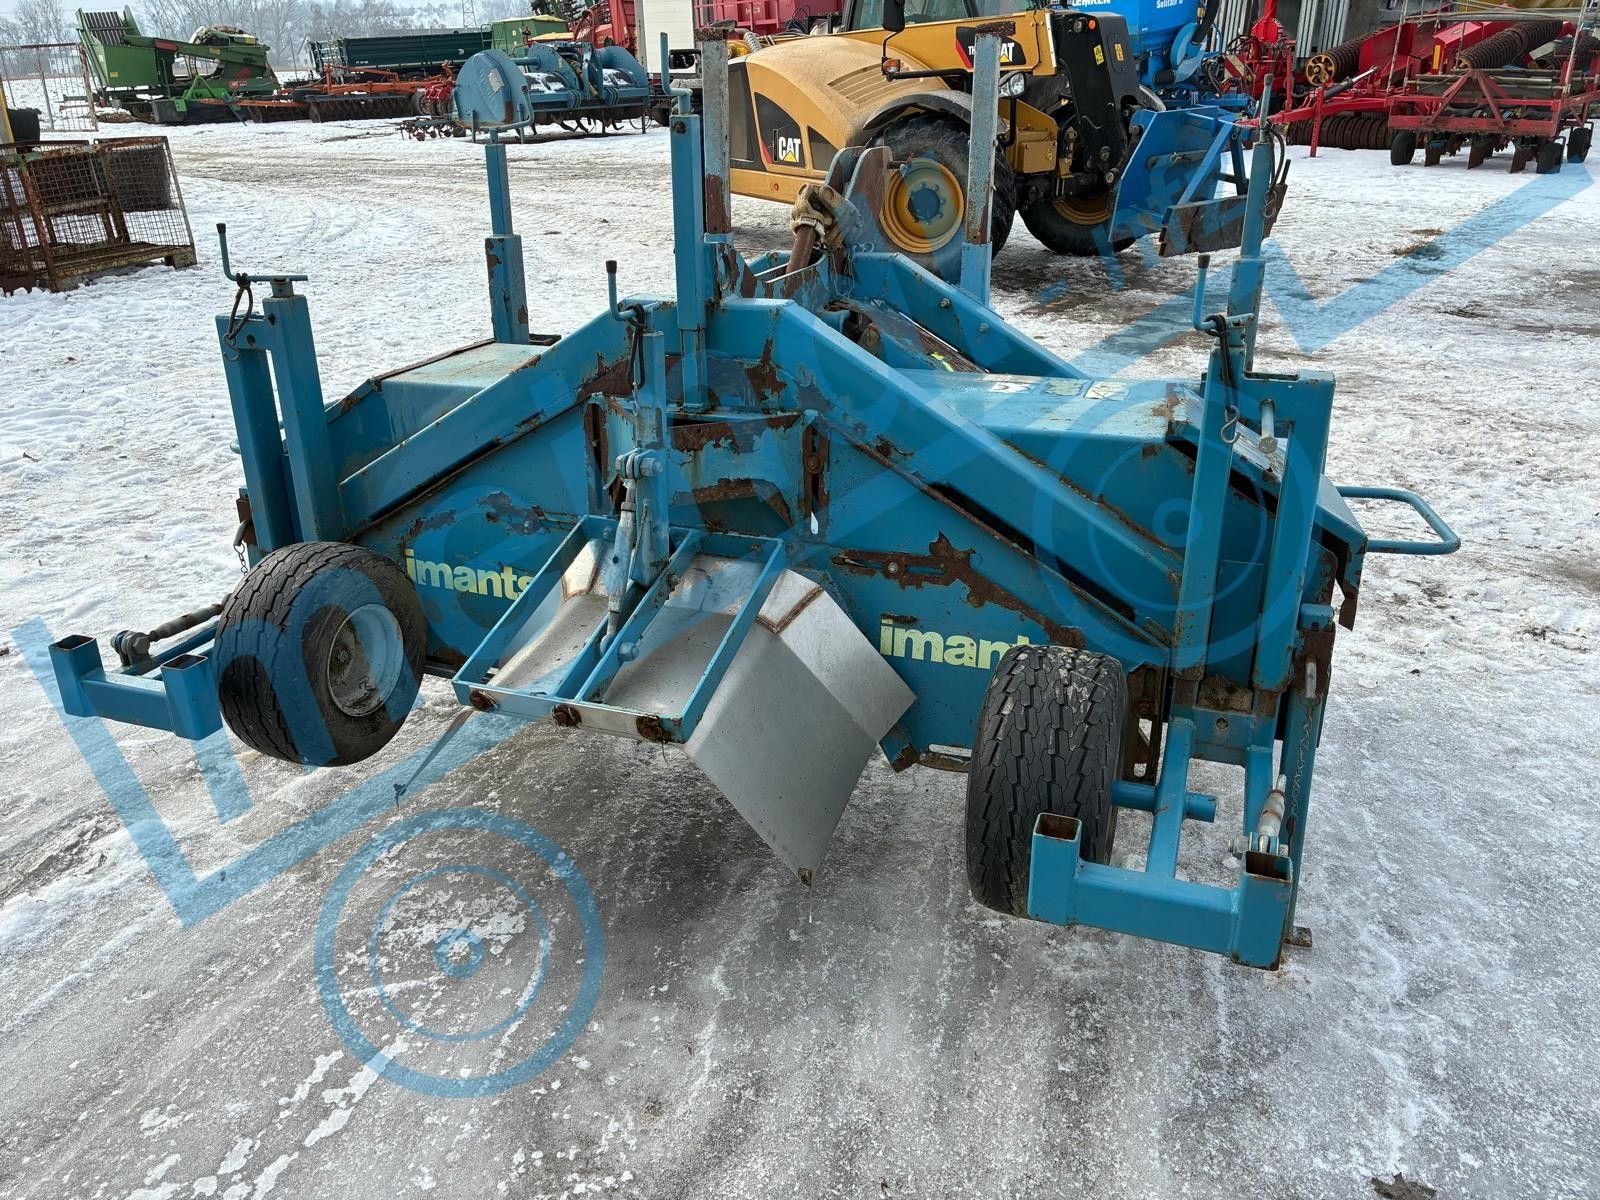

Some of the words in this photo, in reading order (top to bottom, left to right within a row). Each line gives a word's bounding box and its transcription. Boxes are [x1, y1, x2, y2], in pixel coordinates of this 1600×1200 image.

[1000, 42, 1014, 62] AT
[778, 136, 801, 163] CAT
[404, 548, 534, 601] imants
